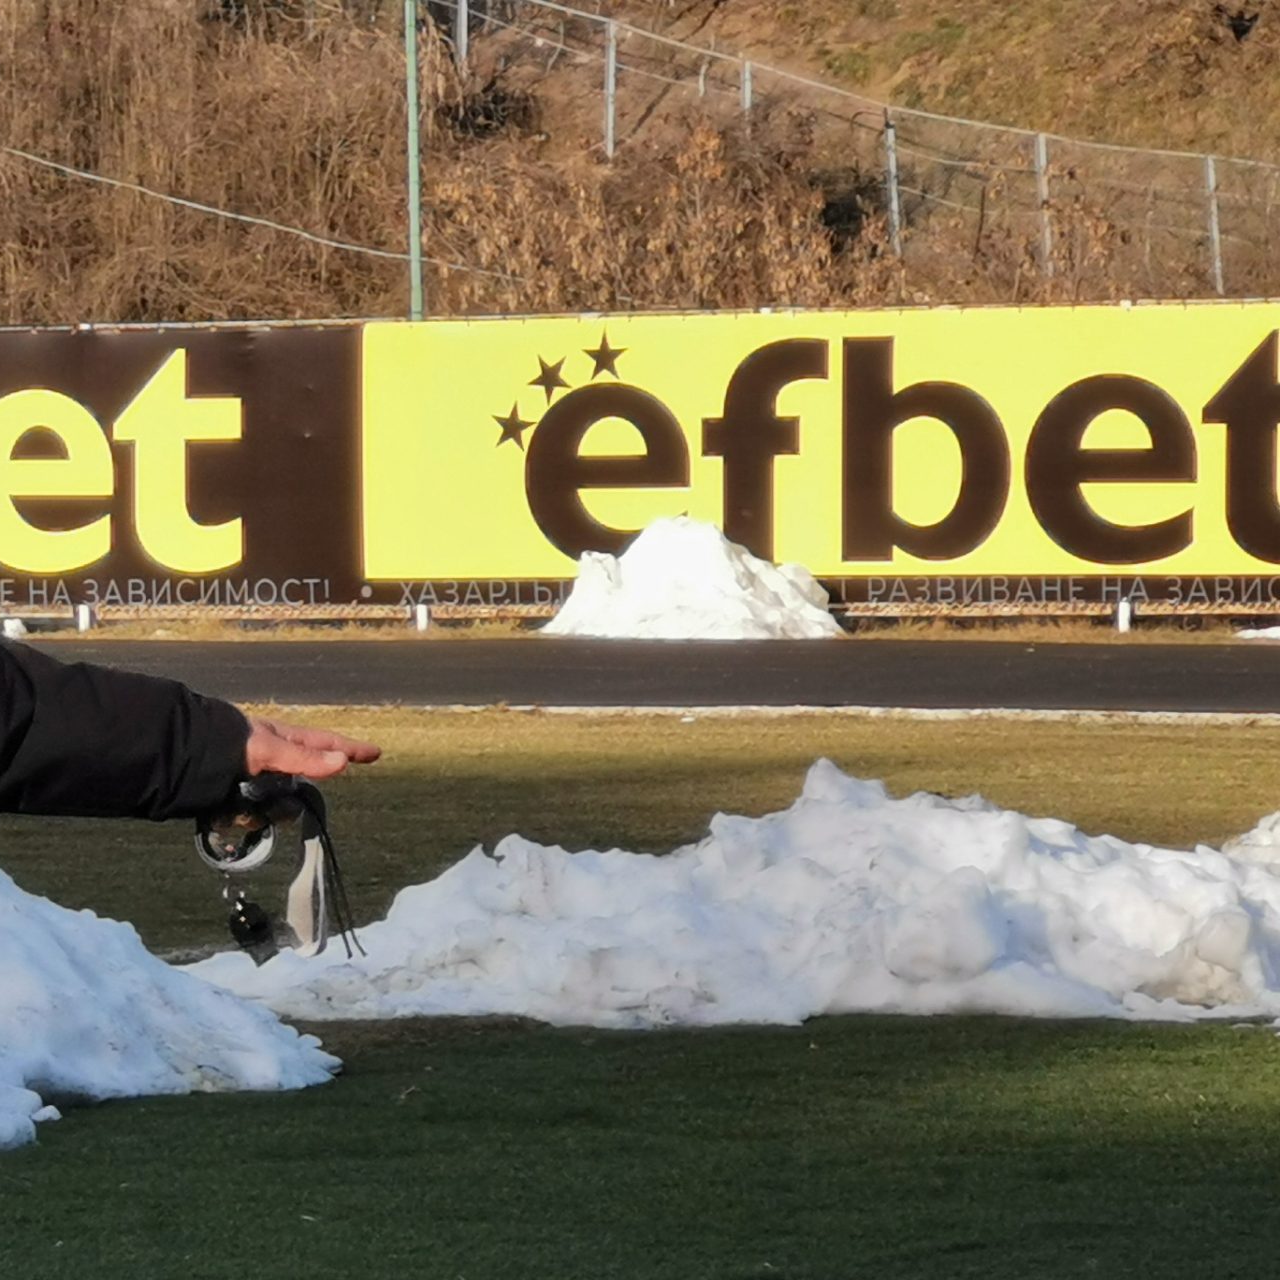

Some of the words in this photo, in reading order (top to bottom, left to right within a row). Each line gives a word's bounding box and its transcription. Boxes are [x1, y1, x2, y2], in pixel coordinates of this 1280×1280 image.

[28, 578, 70, 605] НА
[82, 578, 331, 606] ЗАВИСИМОСТ!
[867, 576, 1085, 603] РАЗВИВАНЕ
[1102, 576, 1150, 602] НА
